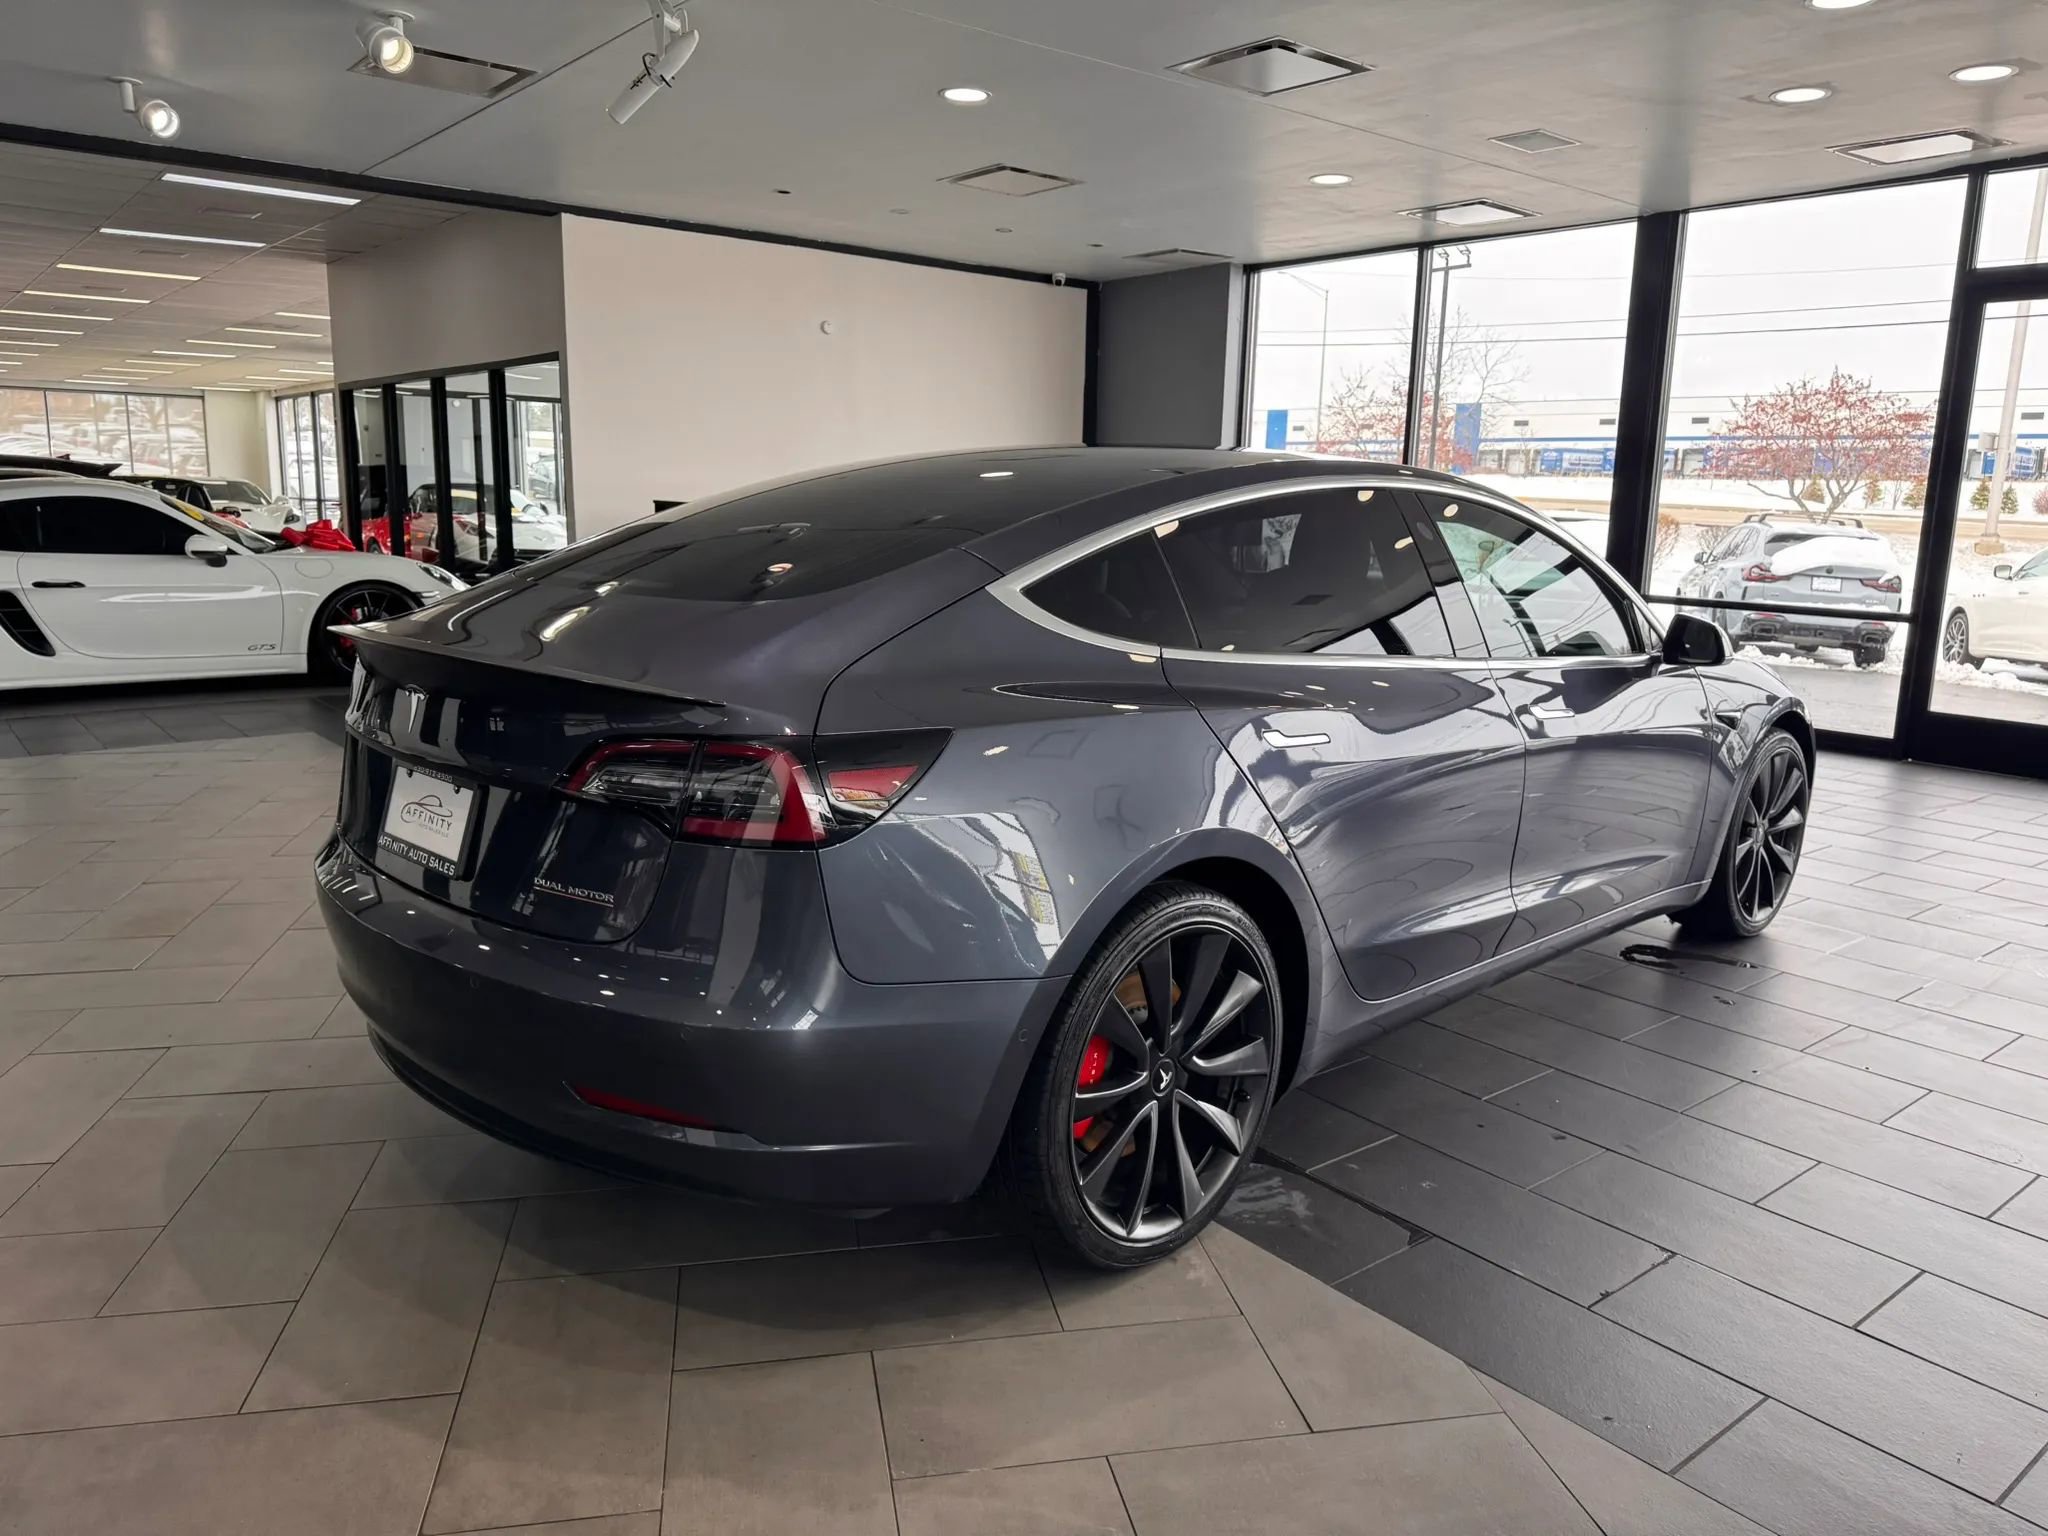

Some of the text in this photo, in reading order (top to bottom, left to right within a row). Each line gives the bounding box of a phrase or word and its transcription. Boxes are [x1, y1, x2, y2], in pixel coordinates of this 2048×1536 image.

[247, 643, 276, 651] GTS
[405, 806, 453, 831] AFFINITY
[378, 834, 456, 876] AFFINITY AUTO SALES
[534, 876, 614, 903] DUAL MOTOR
